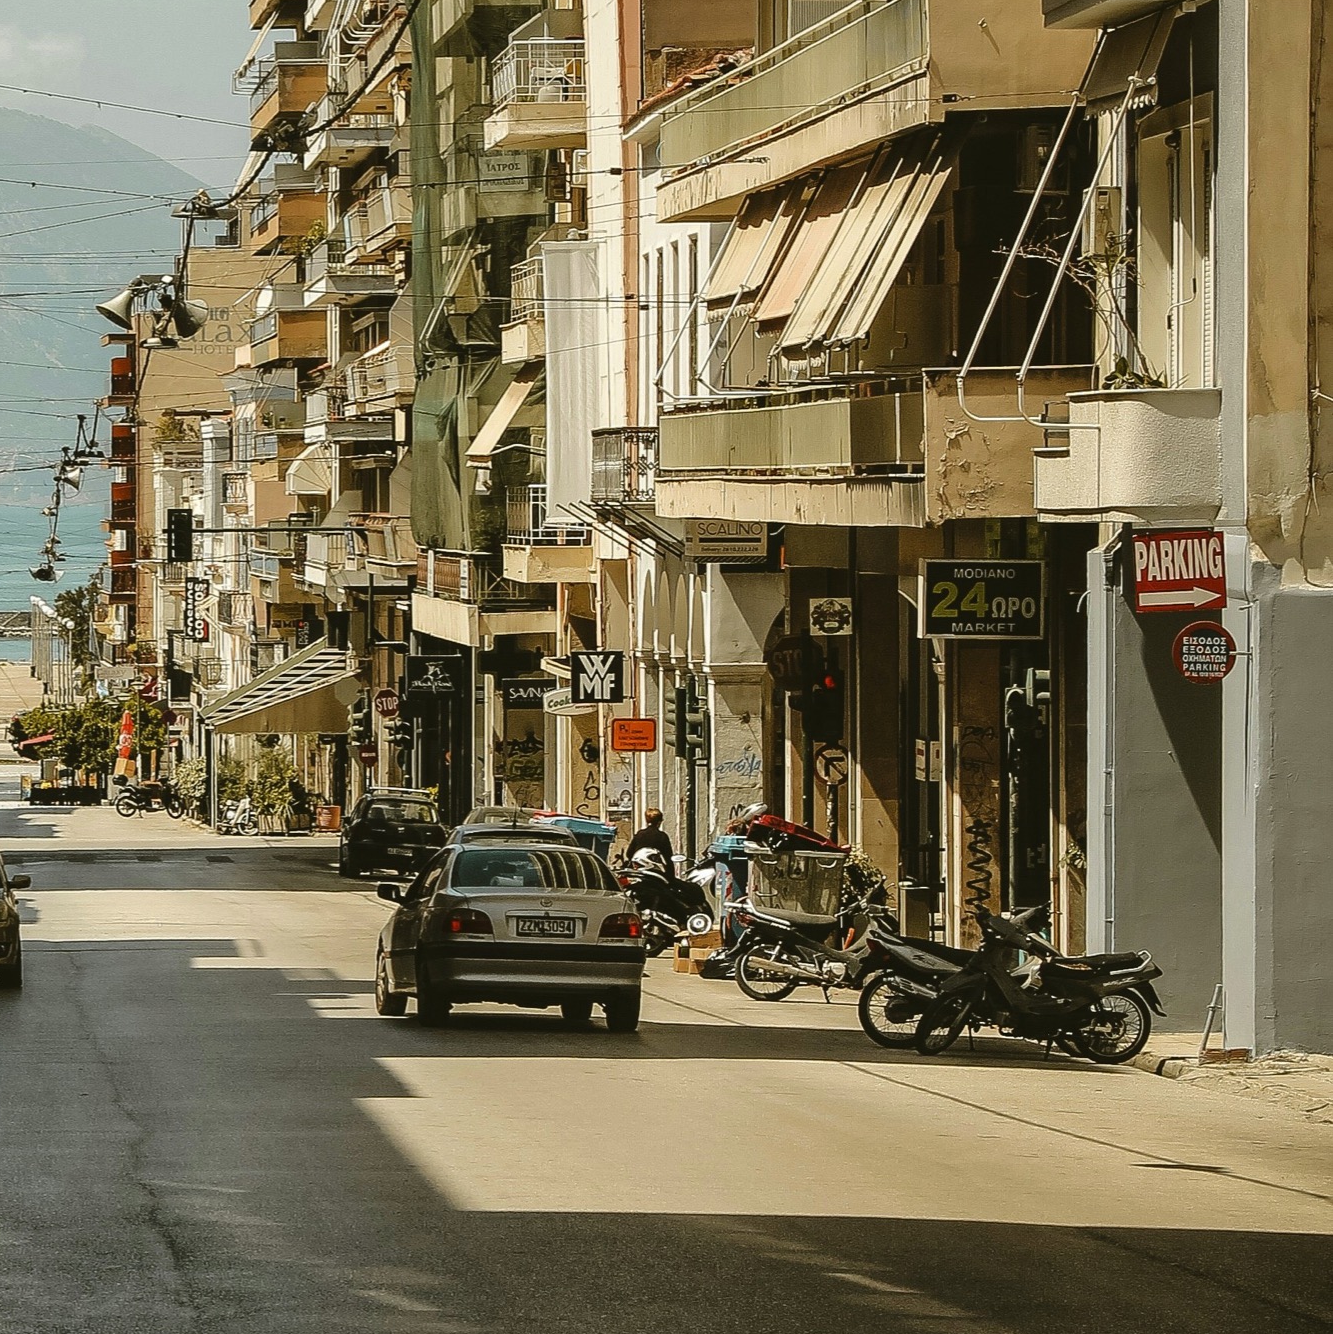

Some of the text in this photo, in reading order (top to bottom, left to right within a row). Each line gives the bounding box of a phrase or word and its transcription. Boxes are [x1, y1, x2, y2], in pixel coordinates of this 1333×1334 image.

[697, 522, 763, 536] SCALINO
[1134, 537, 1223, 582] PARKING
[954, 568, 1016, 579] MODIANO
[194, 583, 205, 639] COSOS
[951, 622, 1016, 633] MARKET
[1182, 636, 1227, 645] ΕΙΣΟΔΟΣ
[1182, 646, 1227, 654] ΕΞΟΔΟΣ
[773, 649, 802, 678] STO
[1182, 654, 1227, 663] ΟΧΗΜΑΤΩΝ
[1183, 663, 1226, 672] PARKING
[578, 655, 615, 699] WMF
[376, 696, 399, 712] STOP
